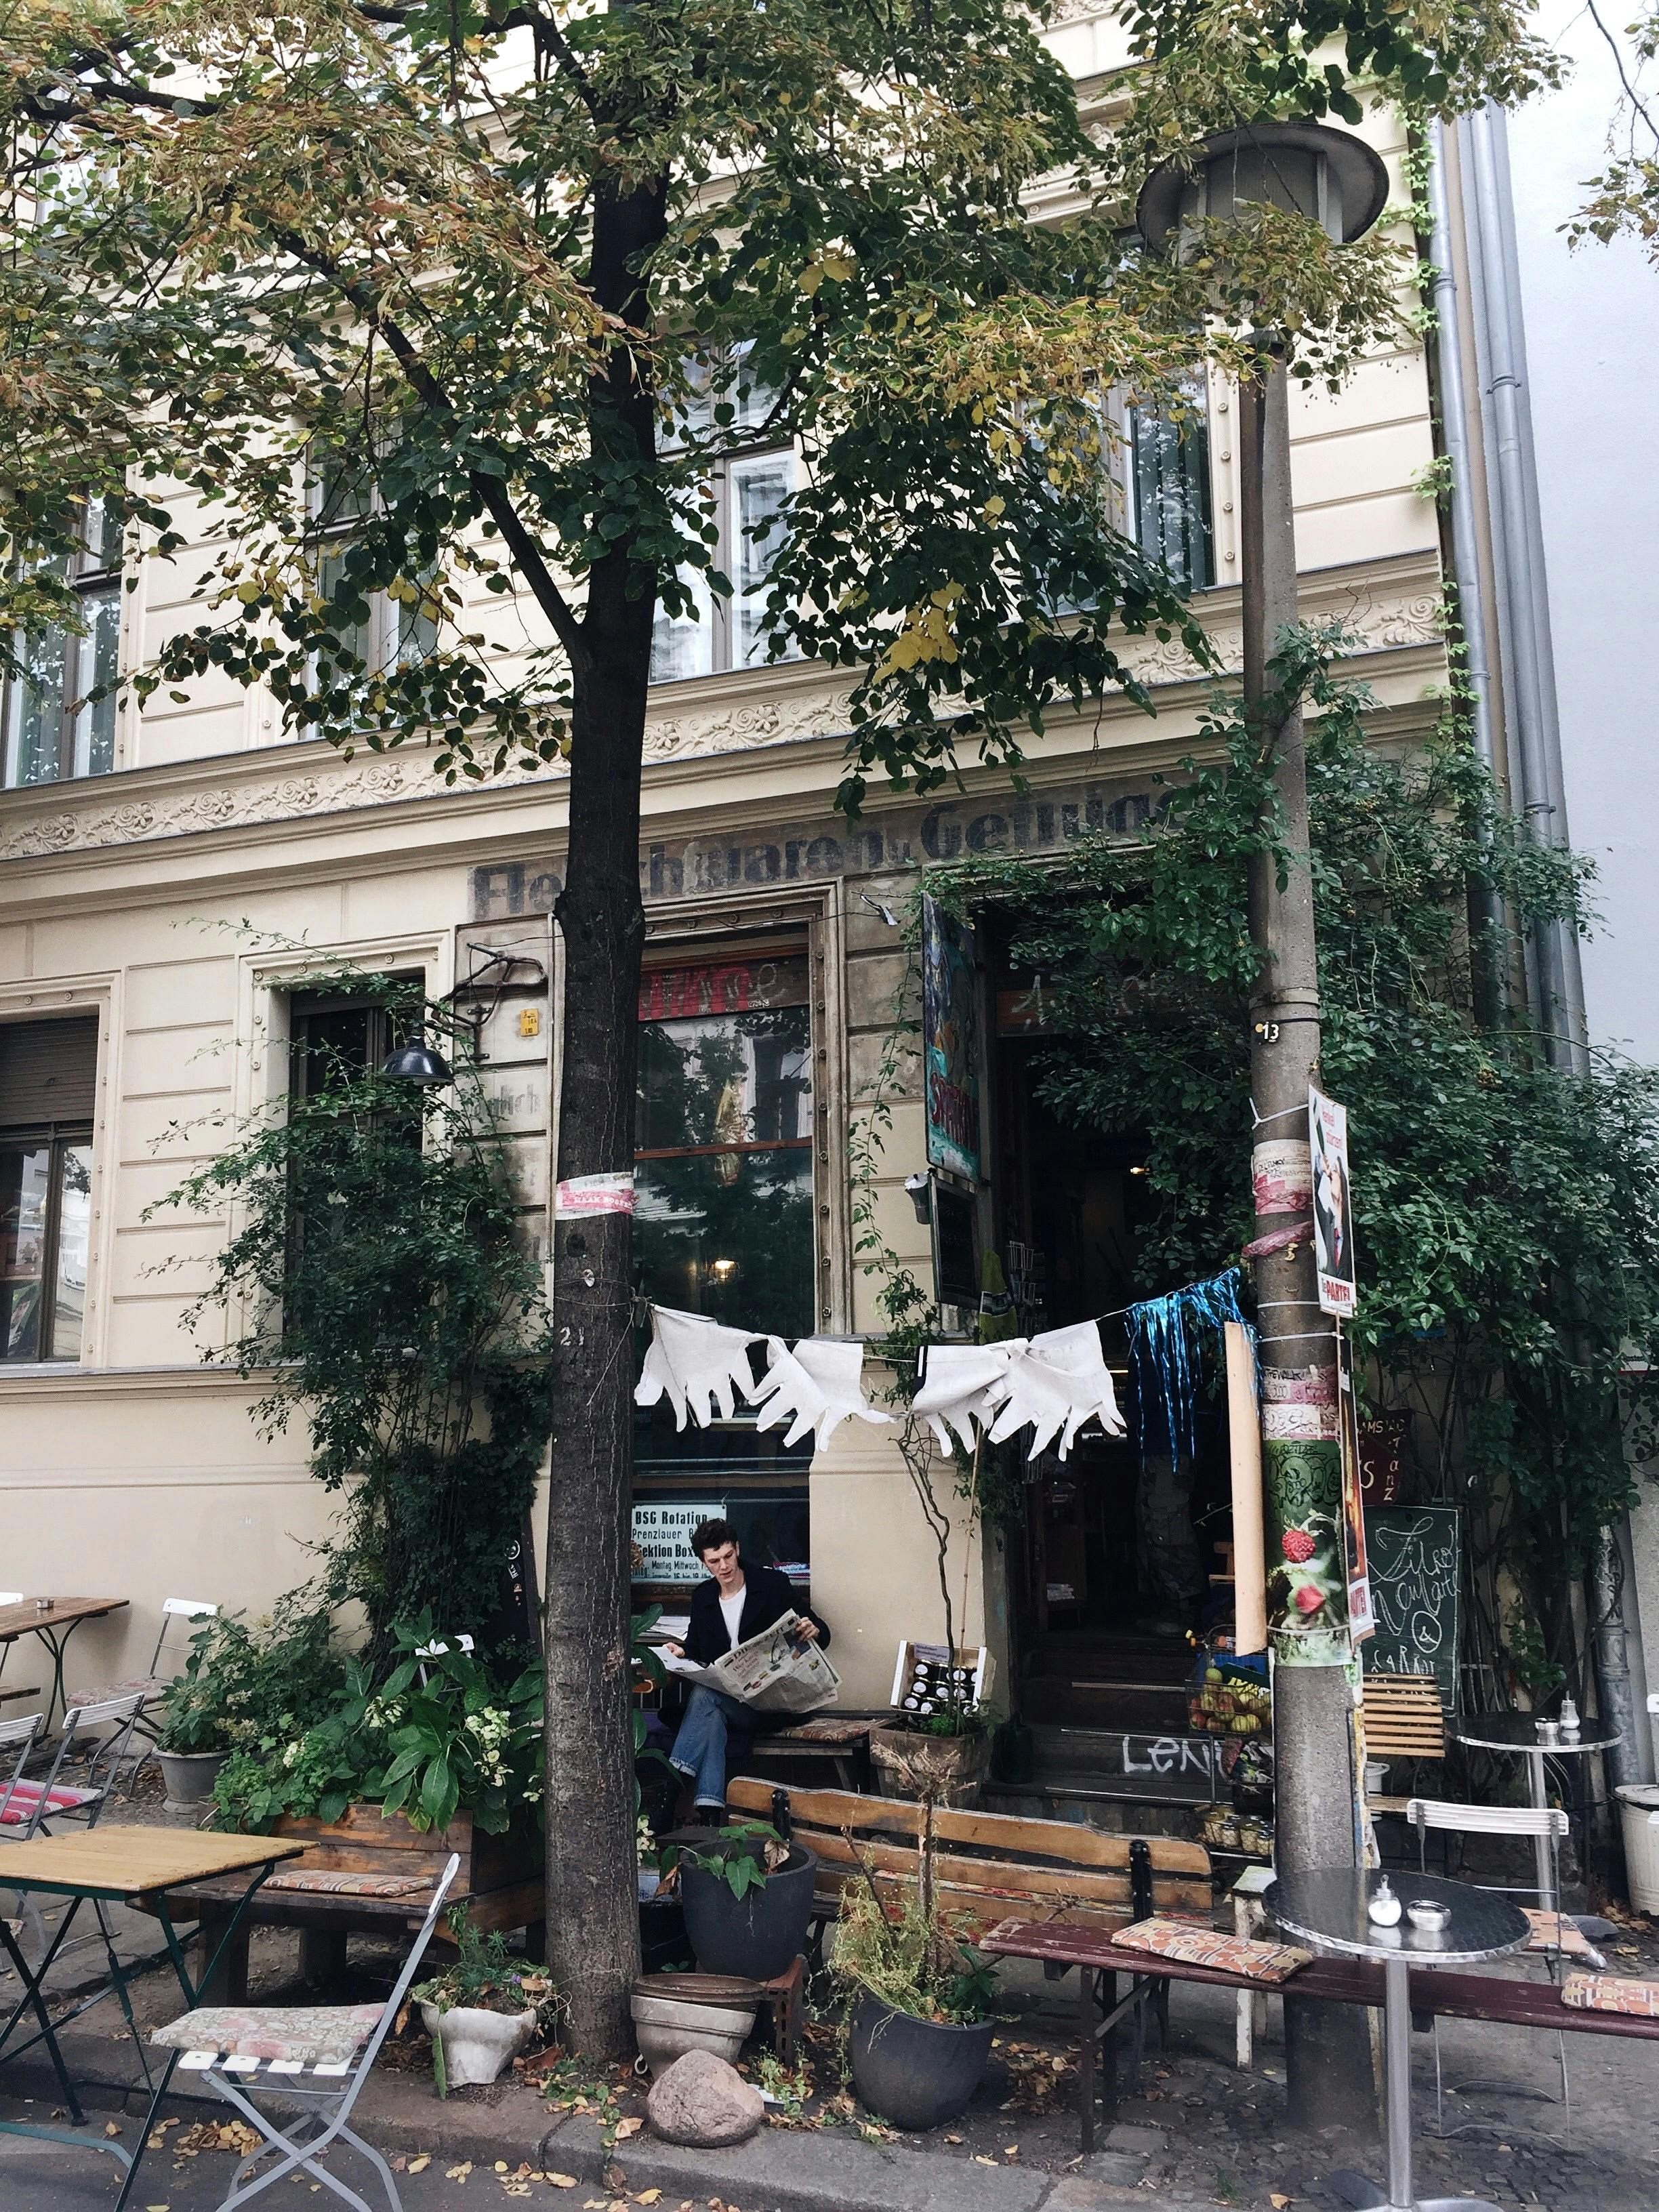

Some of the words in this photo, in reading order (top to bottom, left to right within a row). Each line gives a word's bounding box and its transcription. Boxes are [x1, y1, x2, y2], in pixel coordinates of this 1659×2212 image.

[1326, 1279, 1351, 1302] PARTEI
[635, 1511, 657, 1525] BSG
[661, 1510, 708, 1525] Rotation
[632, 1528, 682, 1540] Prenzlauer
